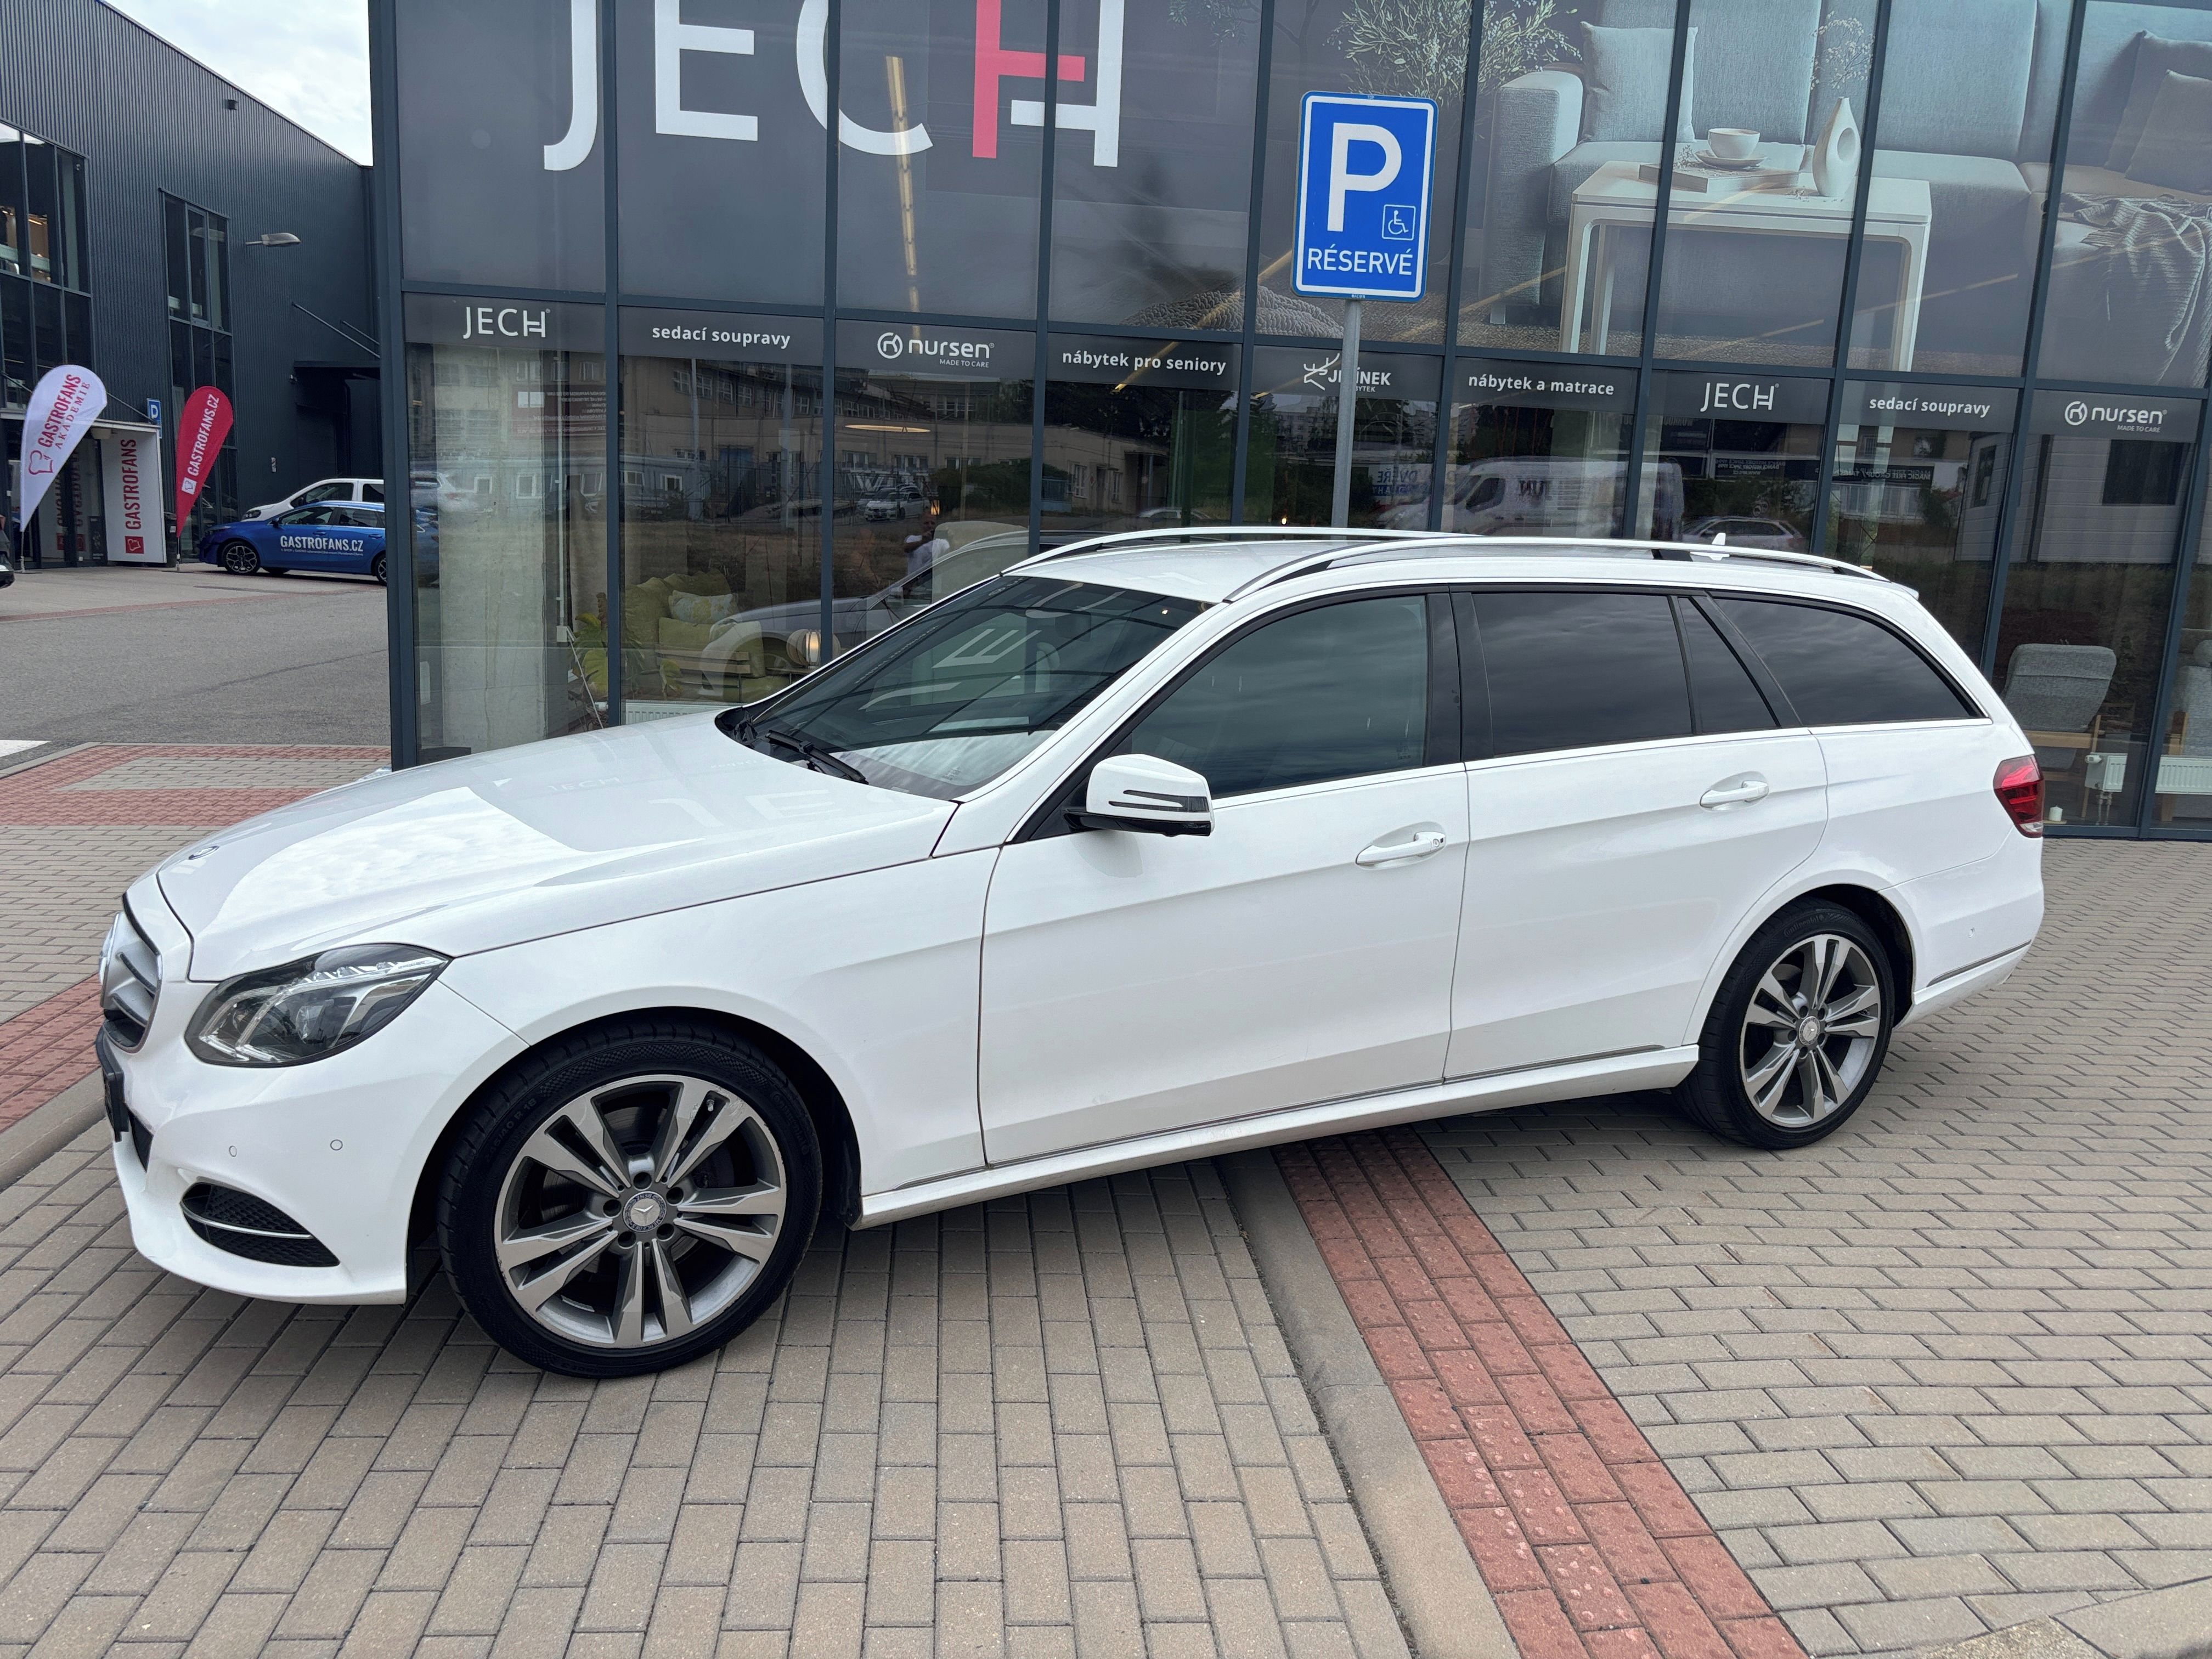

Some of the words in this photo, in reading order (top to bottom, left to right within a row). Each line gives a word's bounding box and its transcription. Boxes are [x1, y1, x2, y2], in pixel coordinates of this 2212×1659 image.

[544, 0, 1124, 171] JECH
[1328, 122, 1402, 232] P
[1307, 244, 1413, 275] RÉSERVÉ
[463, 307, 546, 339] JECH
[652, 326, 707, 341] sedací
[712, 331, 791, 349] soupravy
[909, 339, 990, 358] nursen
[1063, 350, 1129, 368] nábytek
[1134, 357, 1161, 370] pro
[1166, 358, 1227, 376] seniory
[1328, 366, 1392, 386] JIÍNEK
[1469, 374, 1532, 392] nábytek
[1537, 381, 1545, 391] a
[1550, 381, 1614, 395] matrace
[37, 374, 82, 448] GASTROFANS
[1700, 382, 1775, 413] JECH
[1869, 397, 1919, 411] sedací
[1921, 401, 1991, 418] soupravy
[55, 382, 91, 449] AKADEMIE
[2091, 407, 2163, 425] nursen
[188, 394, 219, 477] GASTROFANS.CZ
[121, 439, 142, 530] GASTROFANS
[280, 535, 364, 552] GASTROFANS.CZ
